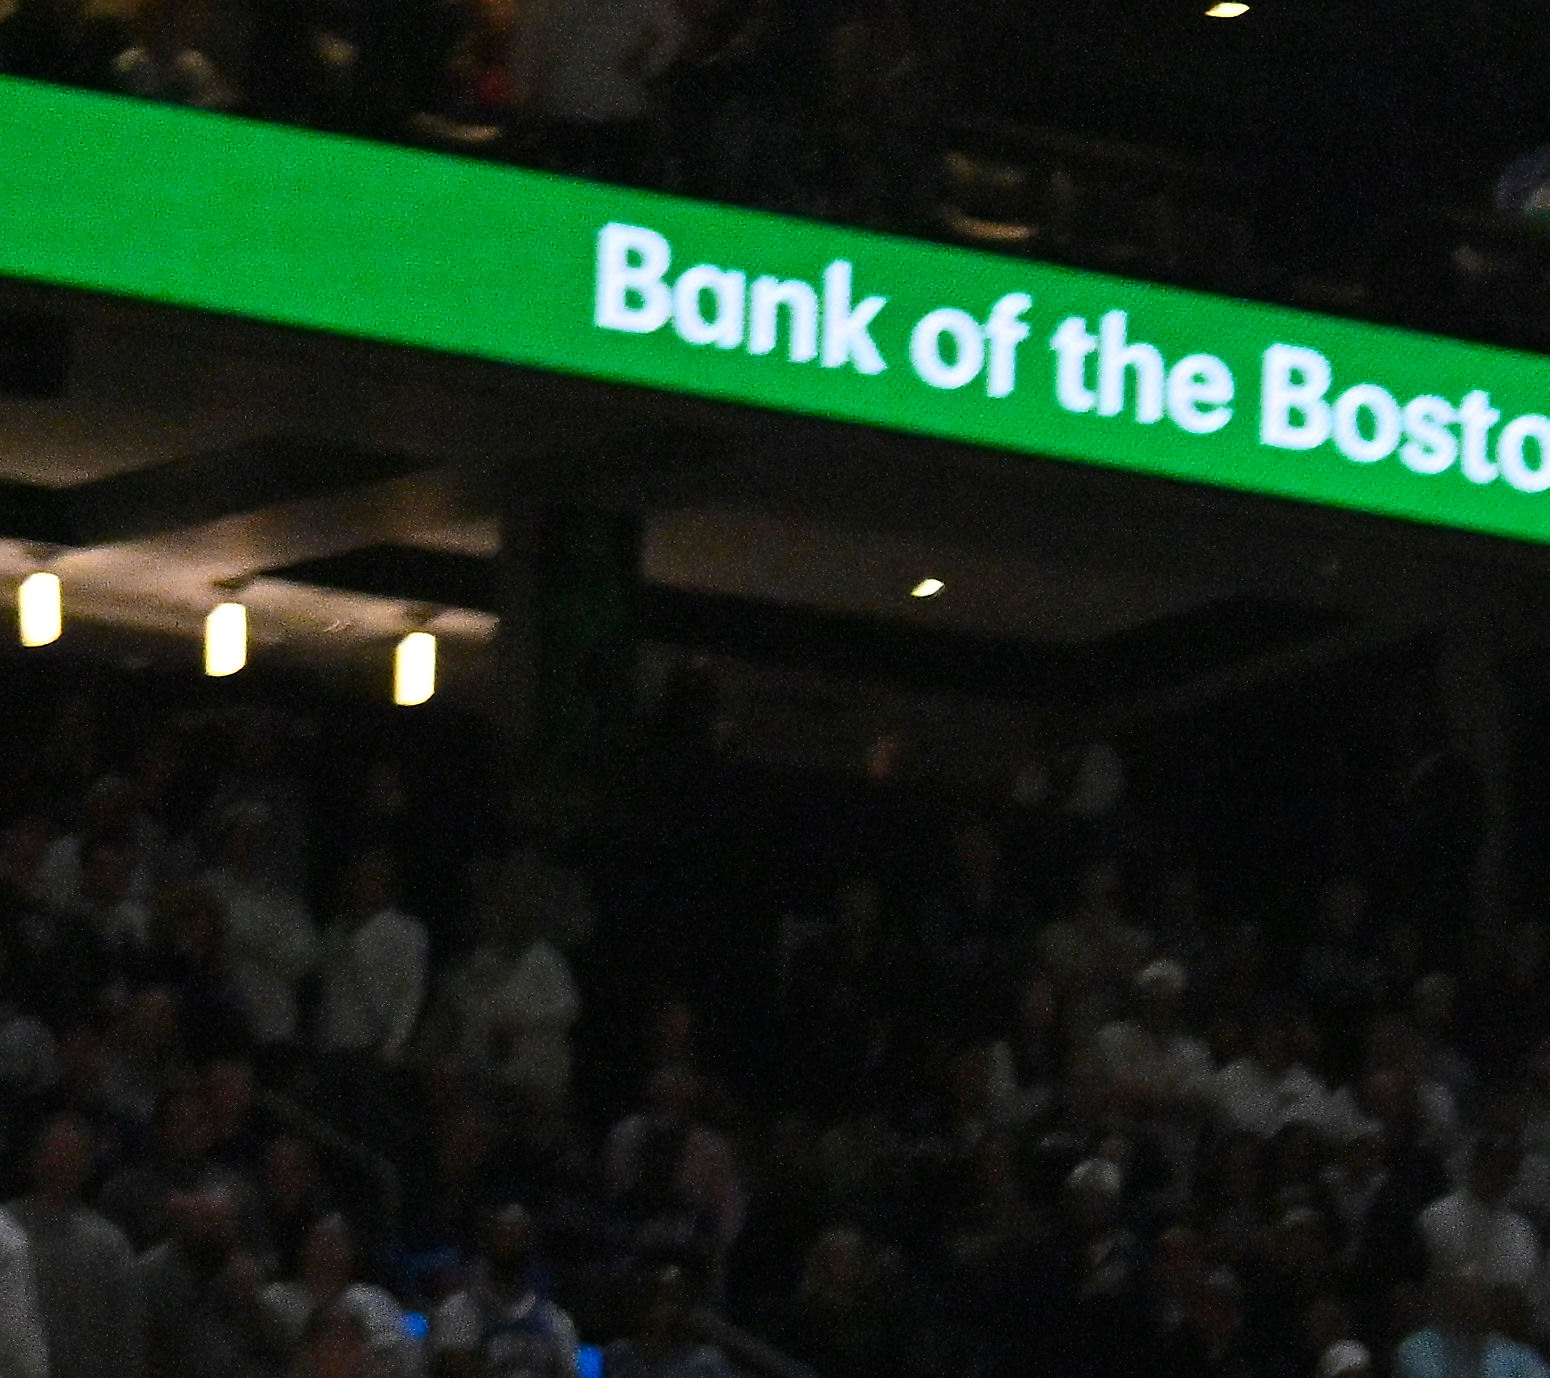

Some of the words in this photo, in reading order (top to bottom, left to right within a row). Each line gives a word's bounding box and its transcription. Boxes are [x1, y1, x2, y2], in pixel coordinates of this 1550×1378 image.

[595, 222, 886, 375] Bank
[910, 294, 1032, 398] of
[1051, 310, 1235, 434] the
